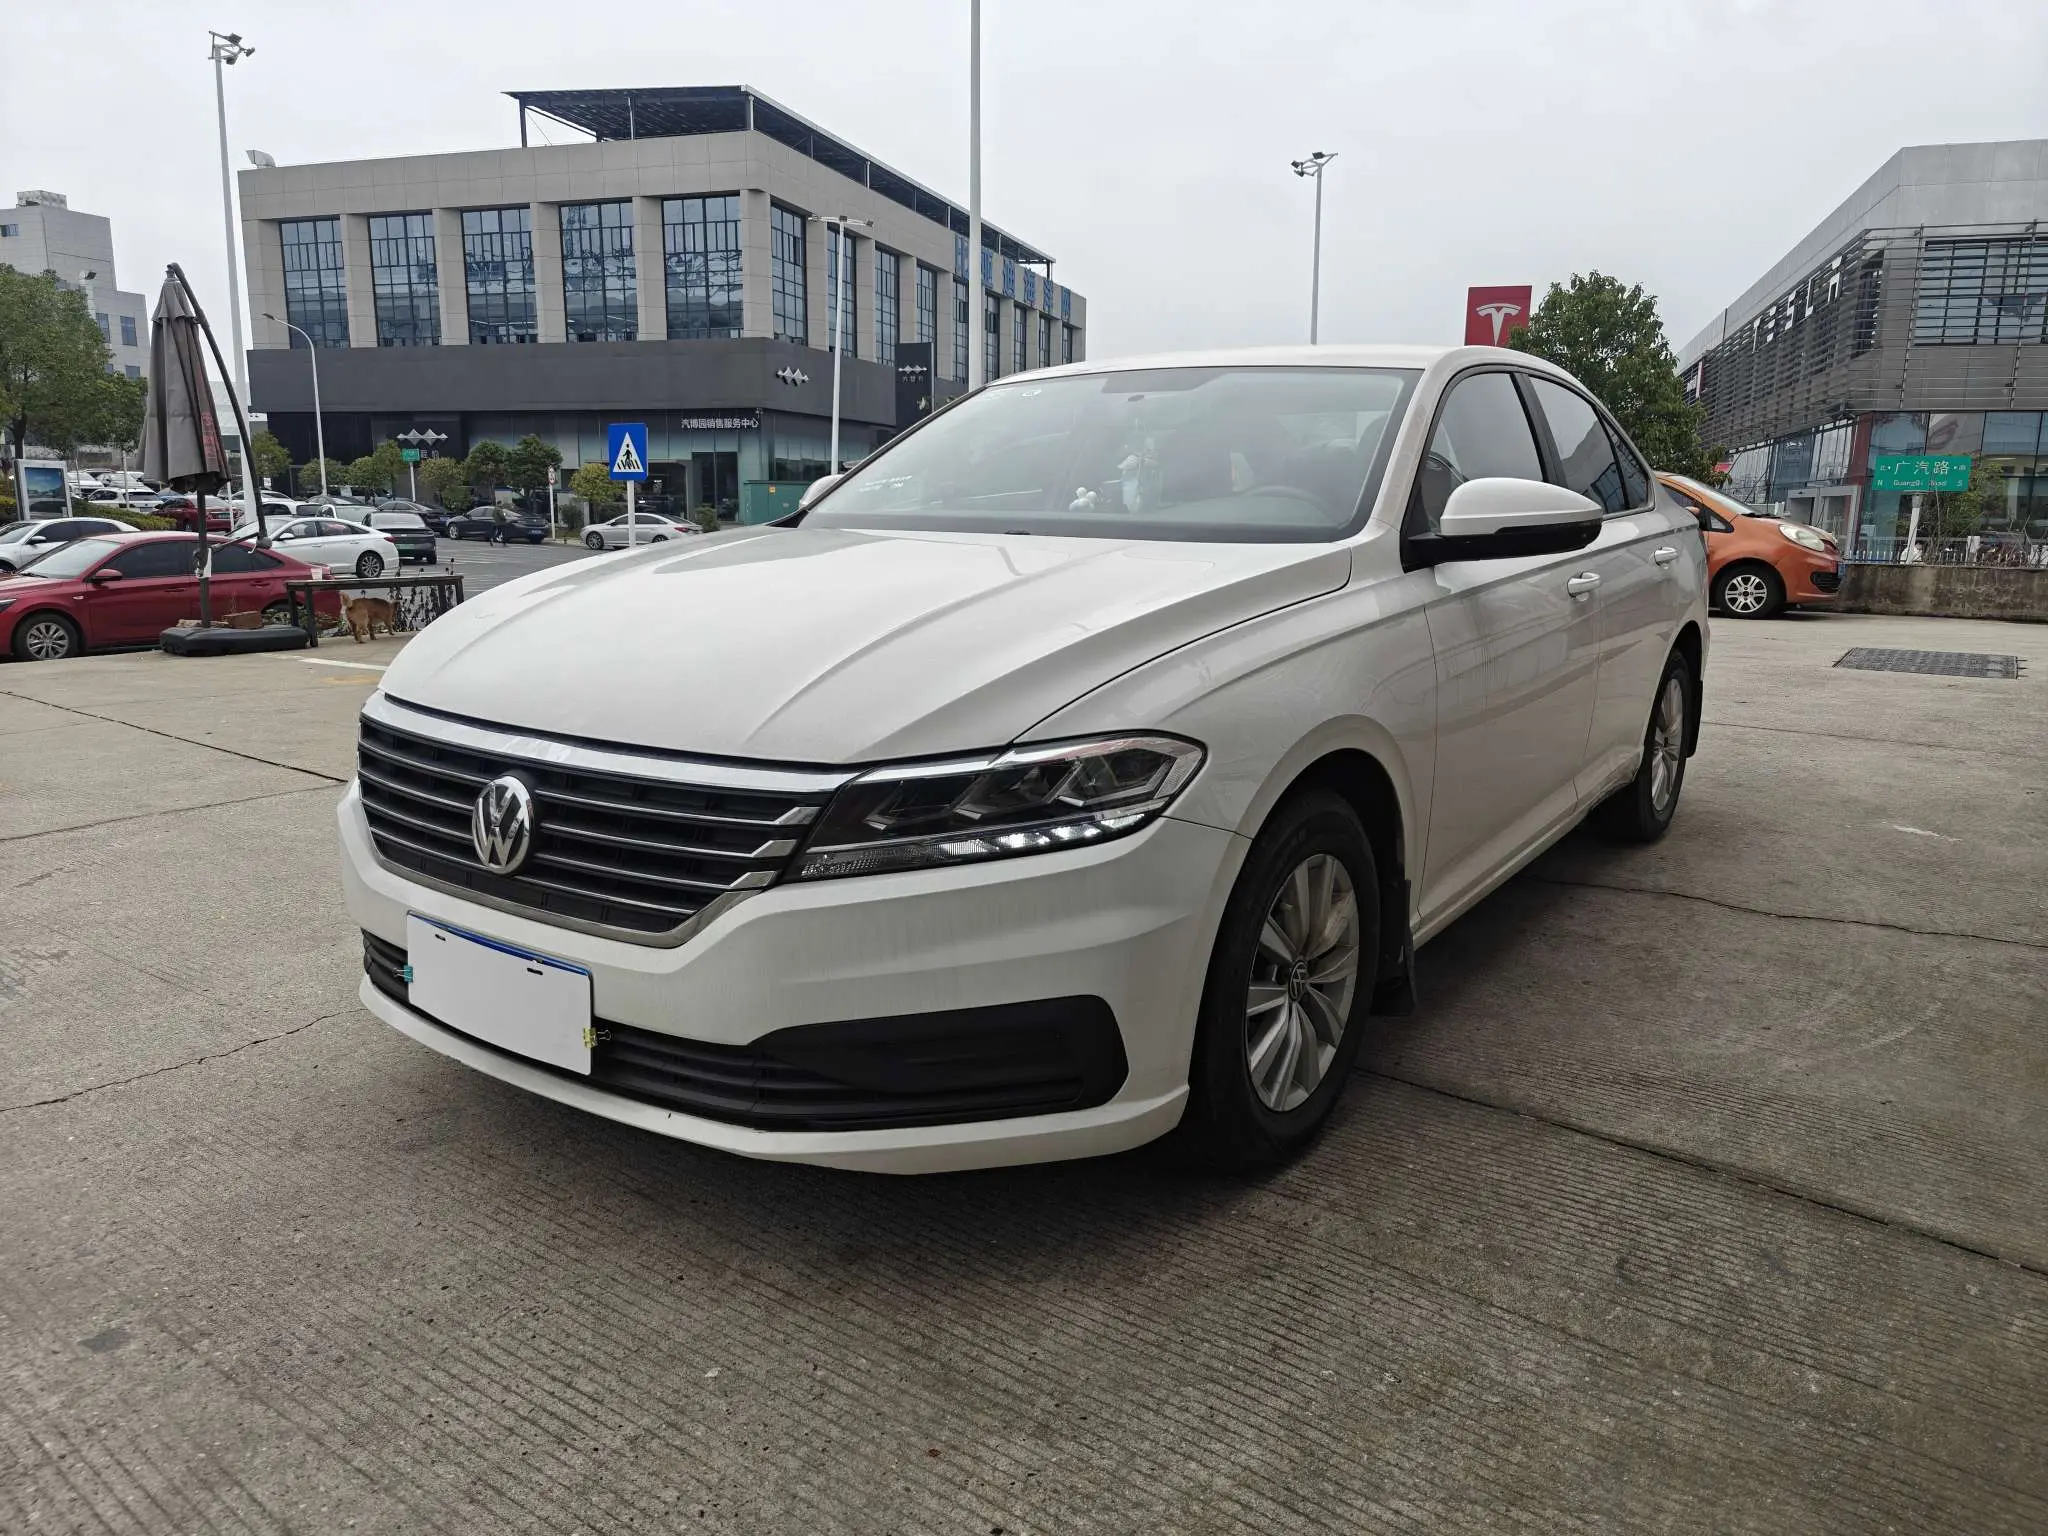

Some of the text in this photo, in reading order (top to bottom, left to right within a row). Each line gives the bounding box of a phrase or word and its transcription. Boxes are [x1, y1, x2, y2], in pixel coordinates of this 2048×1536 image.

[1752, 255, 1842, 353] TESLA
[681, 418, 759, 429] 汽博园销售服务中心
[1894, 461, 1949, 475] 广汽路
